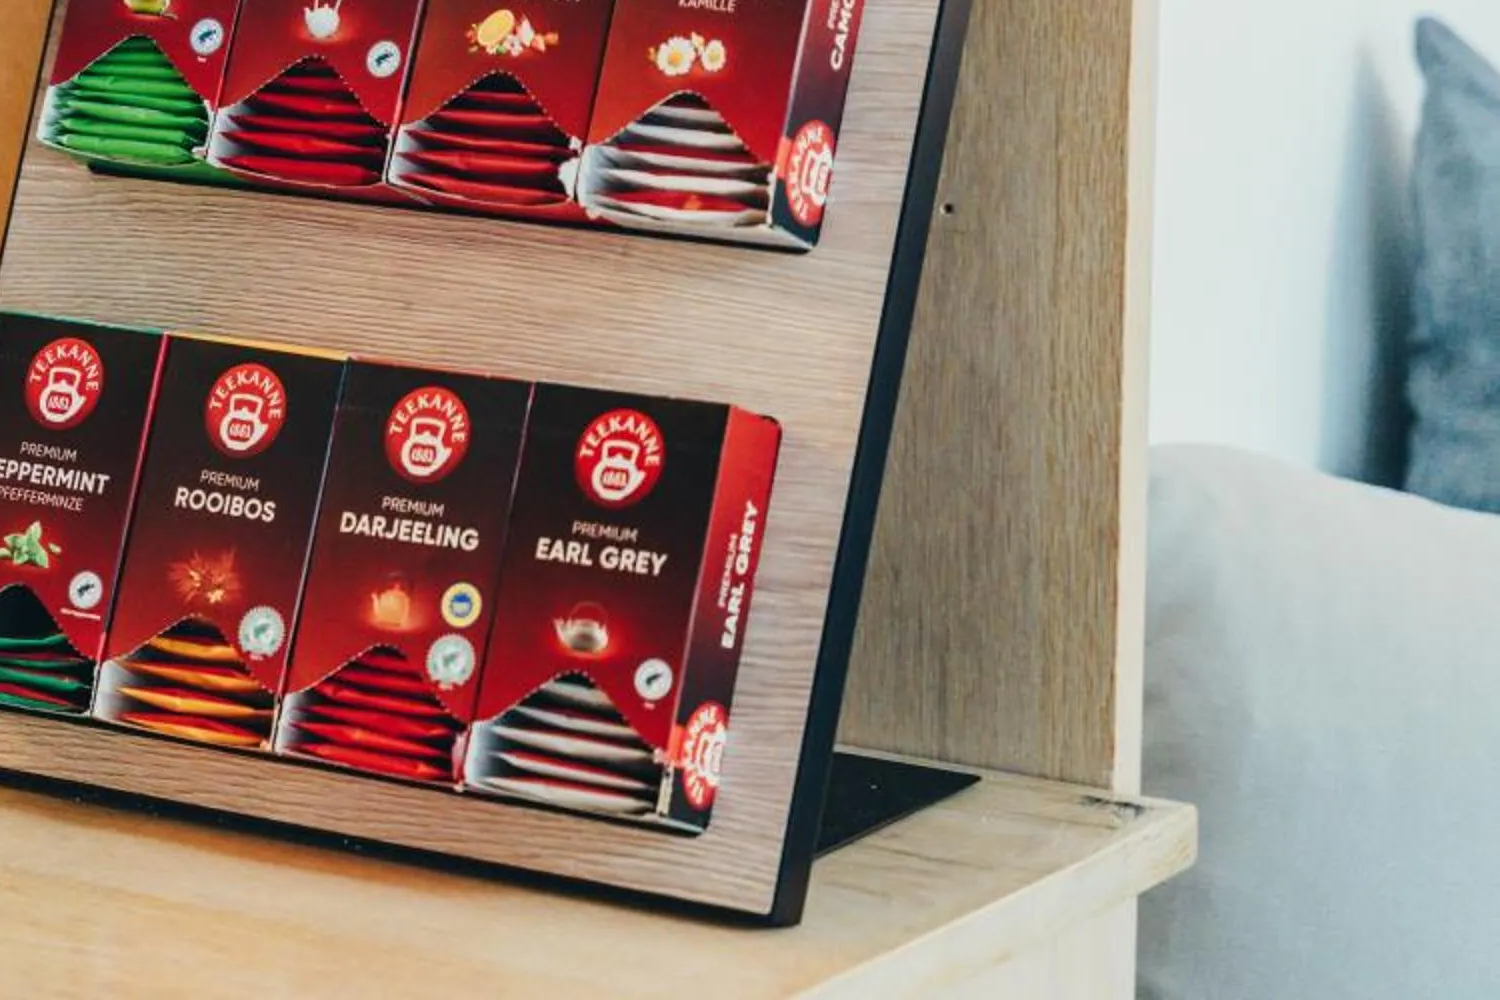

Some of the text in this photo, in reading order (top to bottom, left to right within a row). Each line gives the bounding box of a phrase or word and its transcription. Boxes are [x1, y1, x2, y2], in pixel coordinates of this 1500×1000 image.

[29, 343, 100, 391] TEEKANNE
[209, 370, 282, 420] TEEKANNE
[389, 393, 467, 443] TEEKANNE
[20, 440, 78, 462] PREMIUM
[579, 415, 661, 466] TEEKANNE
[200, 469, 260, 492] PREMIUM
[174, 486, 276, 523] ROOIBOS
[381, 496, 445, 518] PREMIUM
[340, 511, 480, 551] DARJEELING
[571, 520, 639, 543] PREMIUM
[535, 536, 668, 577] EARL GREY
[721, 499, 758, 649] EARL GREY
